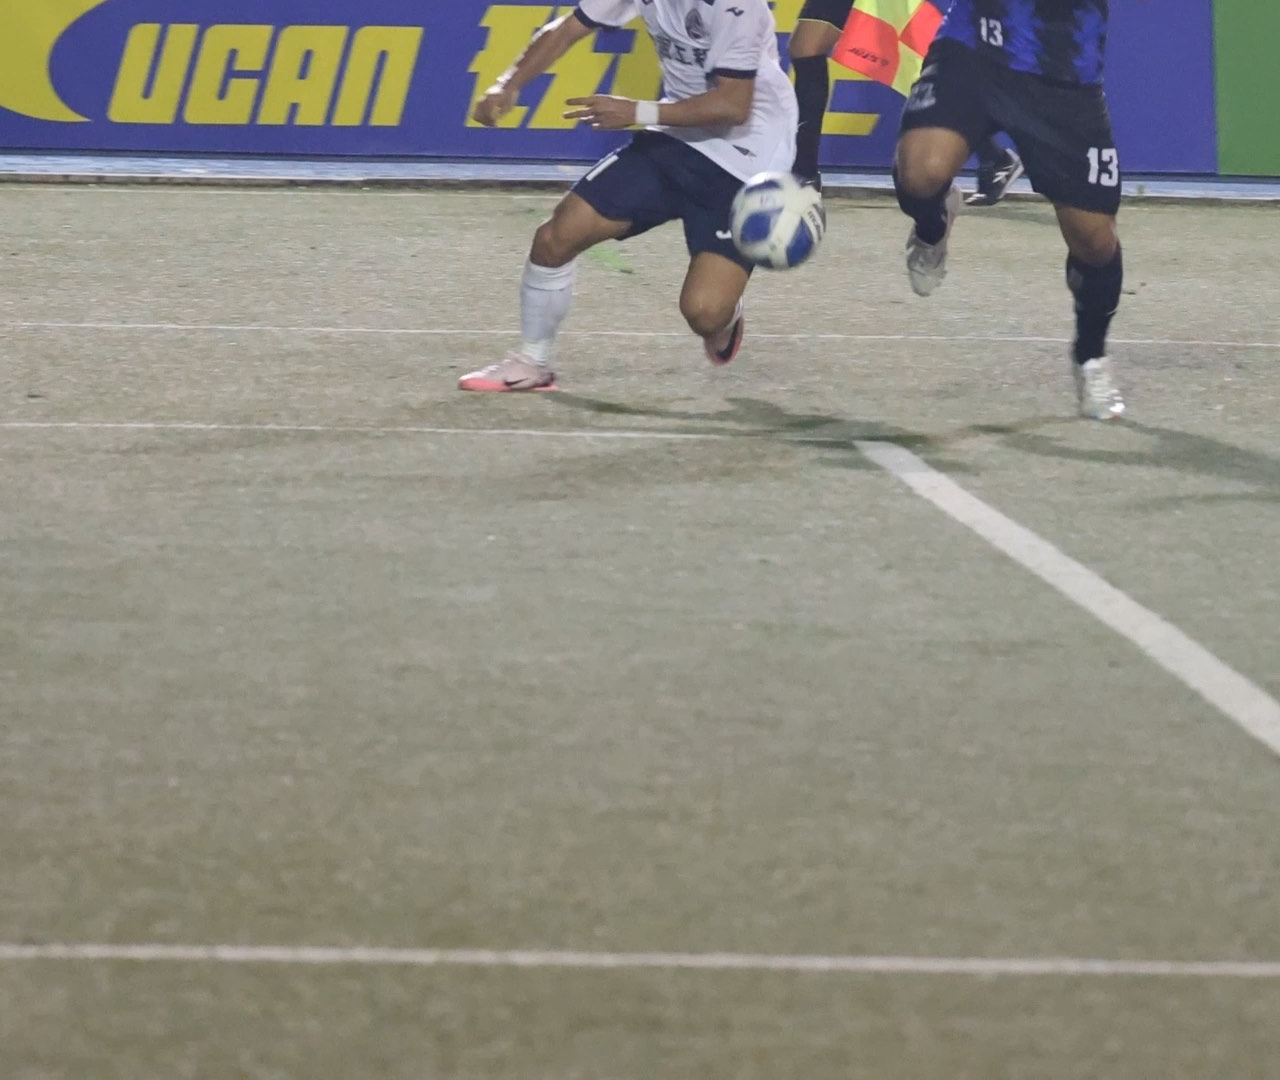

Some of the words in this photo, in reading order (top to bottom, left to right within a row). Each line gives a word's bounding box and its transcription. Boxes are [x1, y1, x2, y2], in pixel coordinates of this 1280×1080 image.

[979, 16, 1004, 48] 13
[107, 23, 424, 127] UCAN
[1085, 146, 1119, 187] 13
